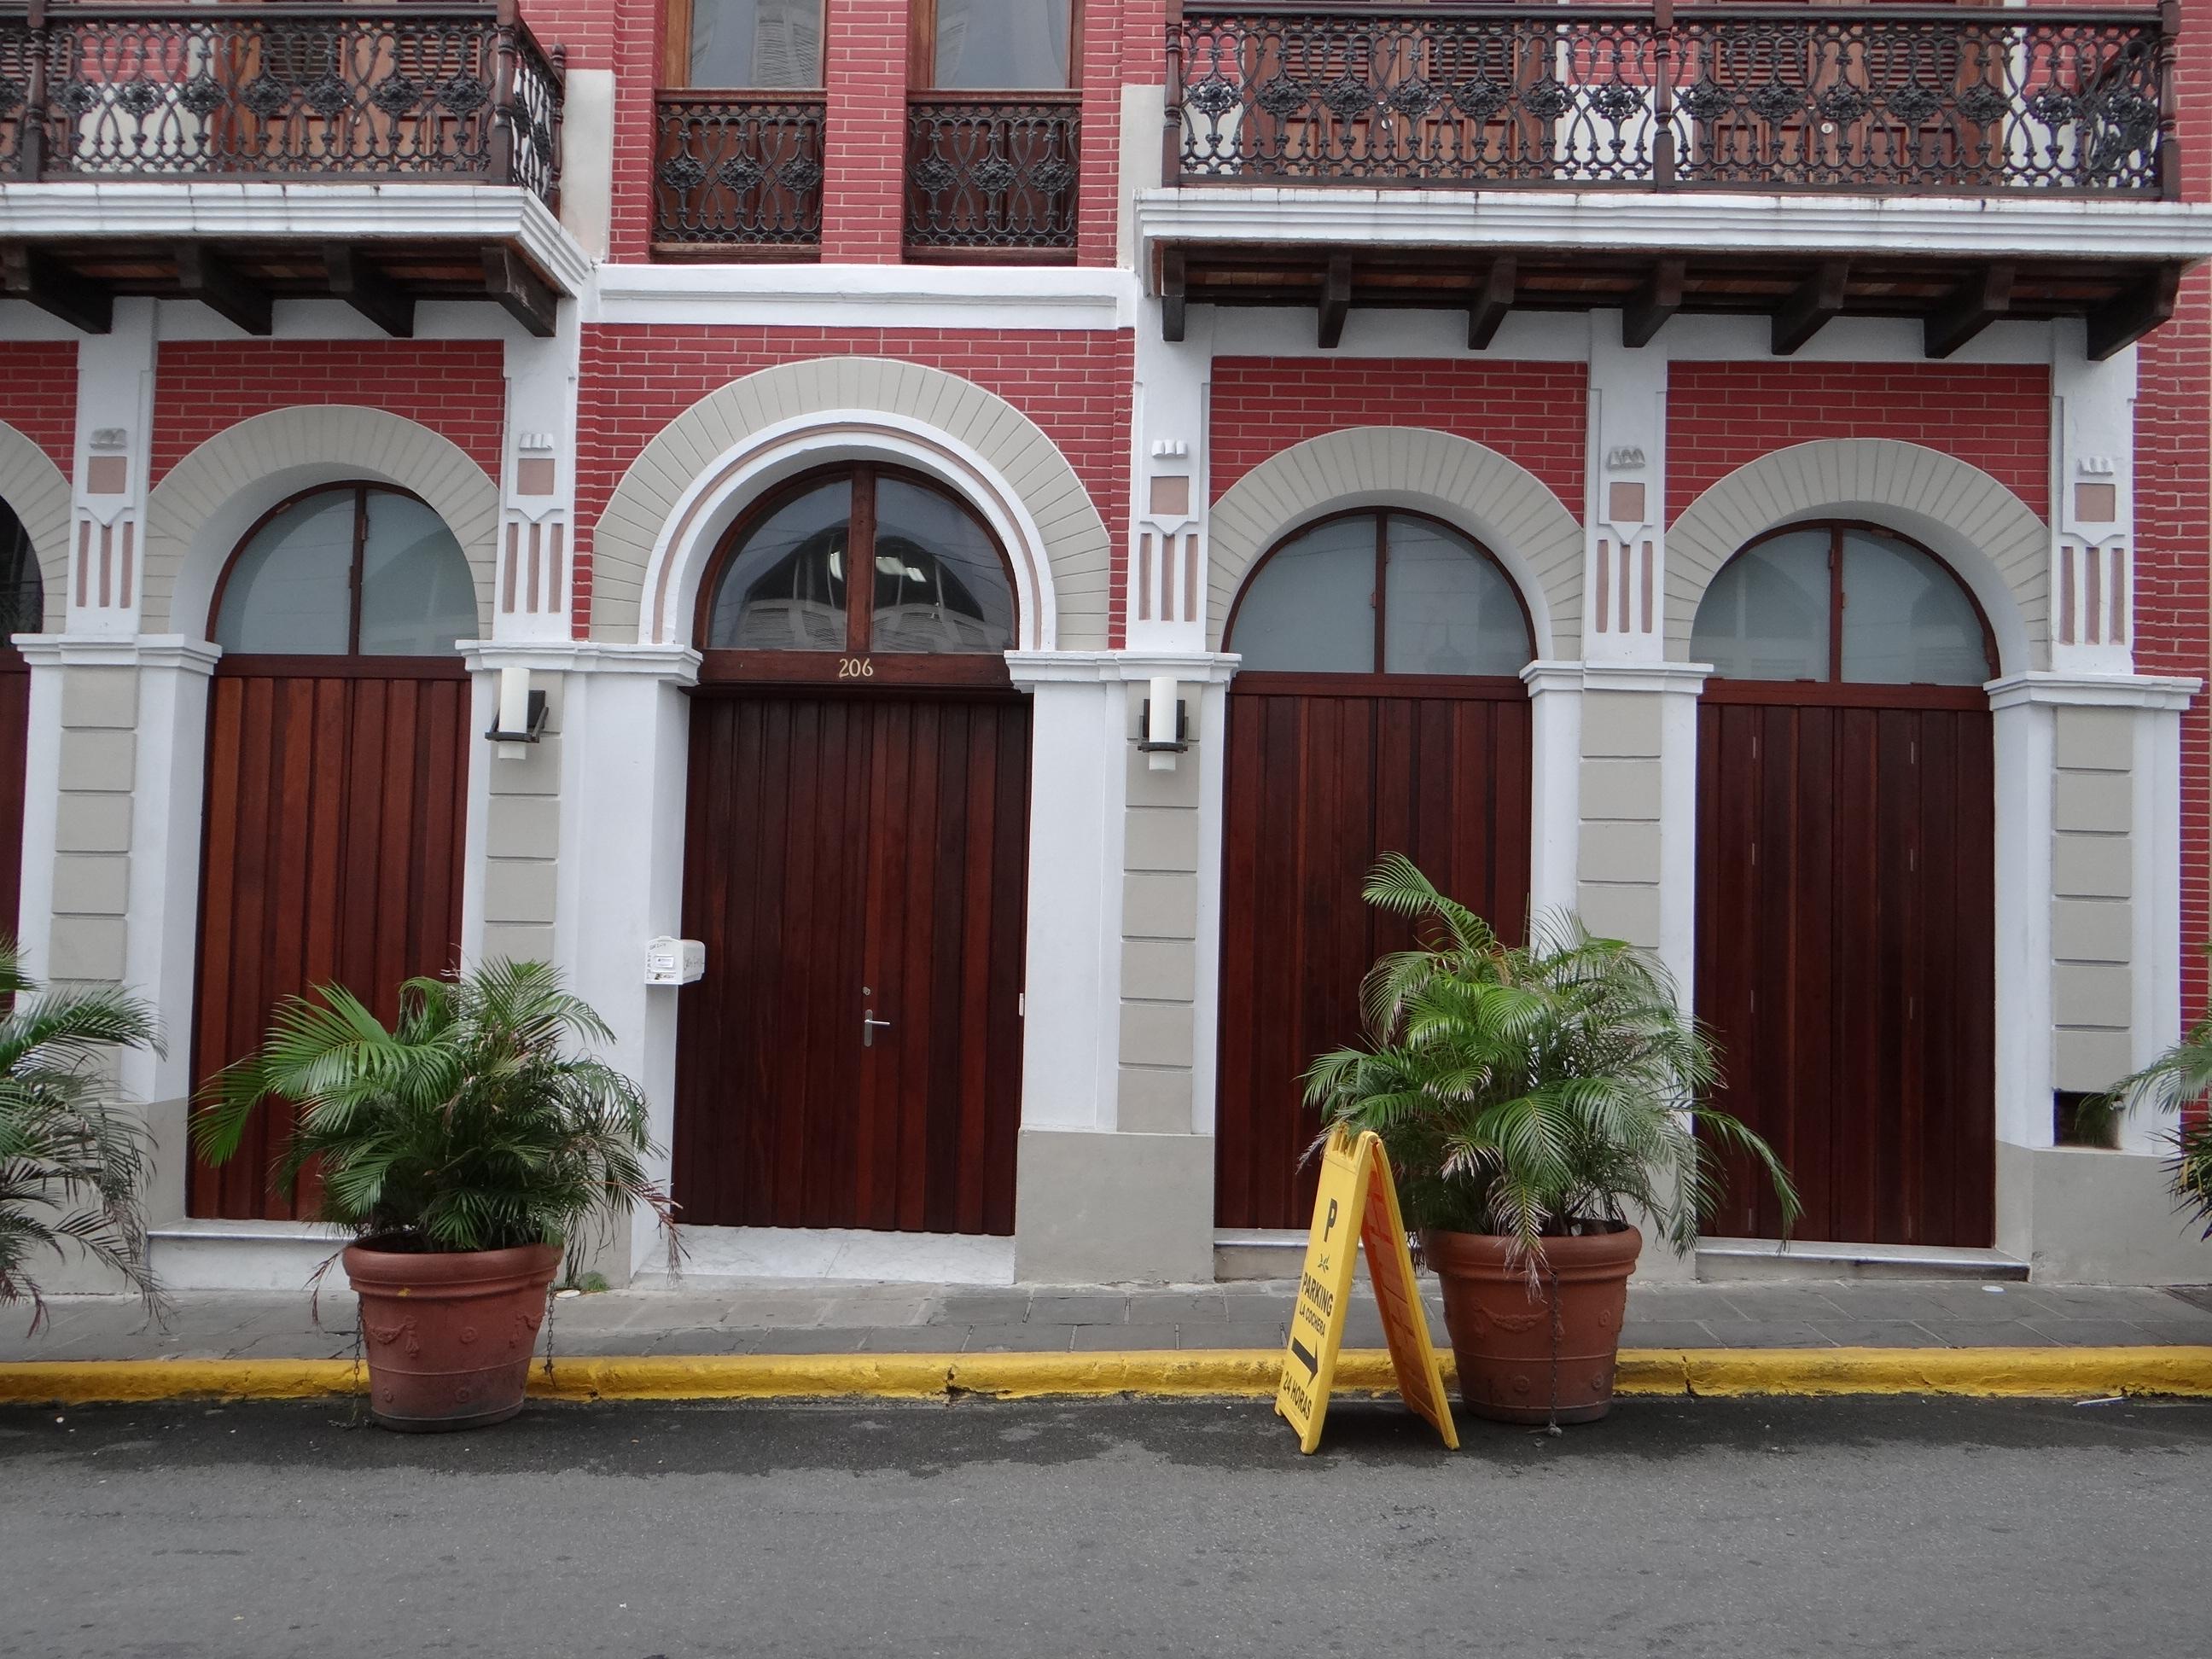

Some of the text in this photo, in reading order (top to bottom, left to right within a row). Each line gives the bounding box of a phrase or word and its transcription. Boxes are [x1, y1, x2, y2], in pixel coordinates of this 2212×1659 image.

[839, 658, 874, 678] 206
[1324, 1198, 1338, 1243] P
[1301, 1272, 1334, 1317] PARKING
[1299, 1302, 1326, 1337] LA COCHERA
[1283, 1371, 1312, 1420] 24 HORAS
